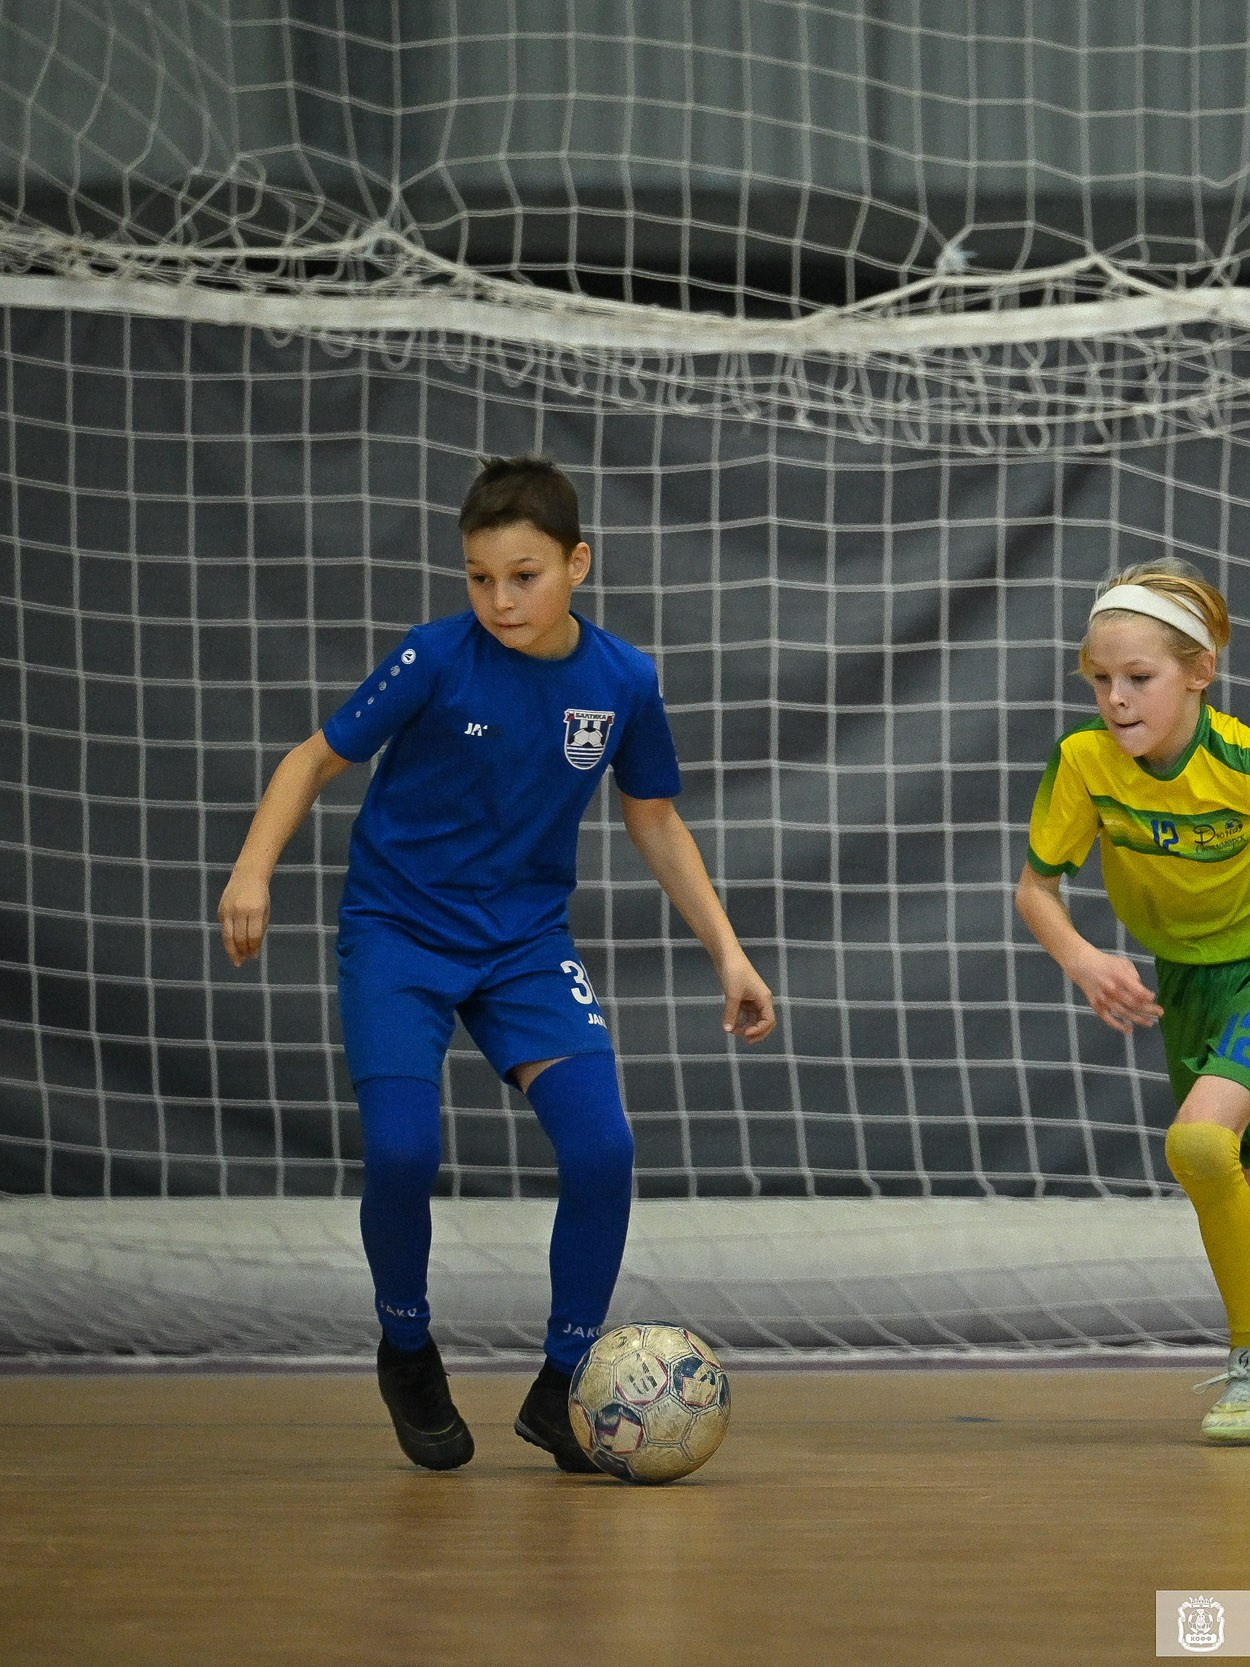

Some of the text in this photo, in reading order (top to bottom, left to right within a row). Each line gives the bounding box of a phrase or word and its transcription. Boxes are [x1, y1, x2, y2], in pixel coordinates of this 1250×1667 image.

[464, 722, 489, 737] JA
[1150, 818, 1181, 856] 12
[560, 960, 600, 1007] 3
